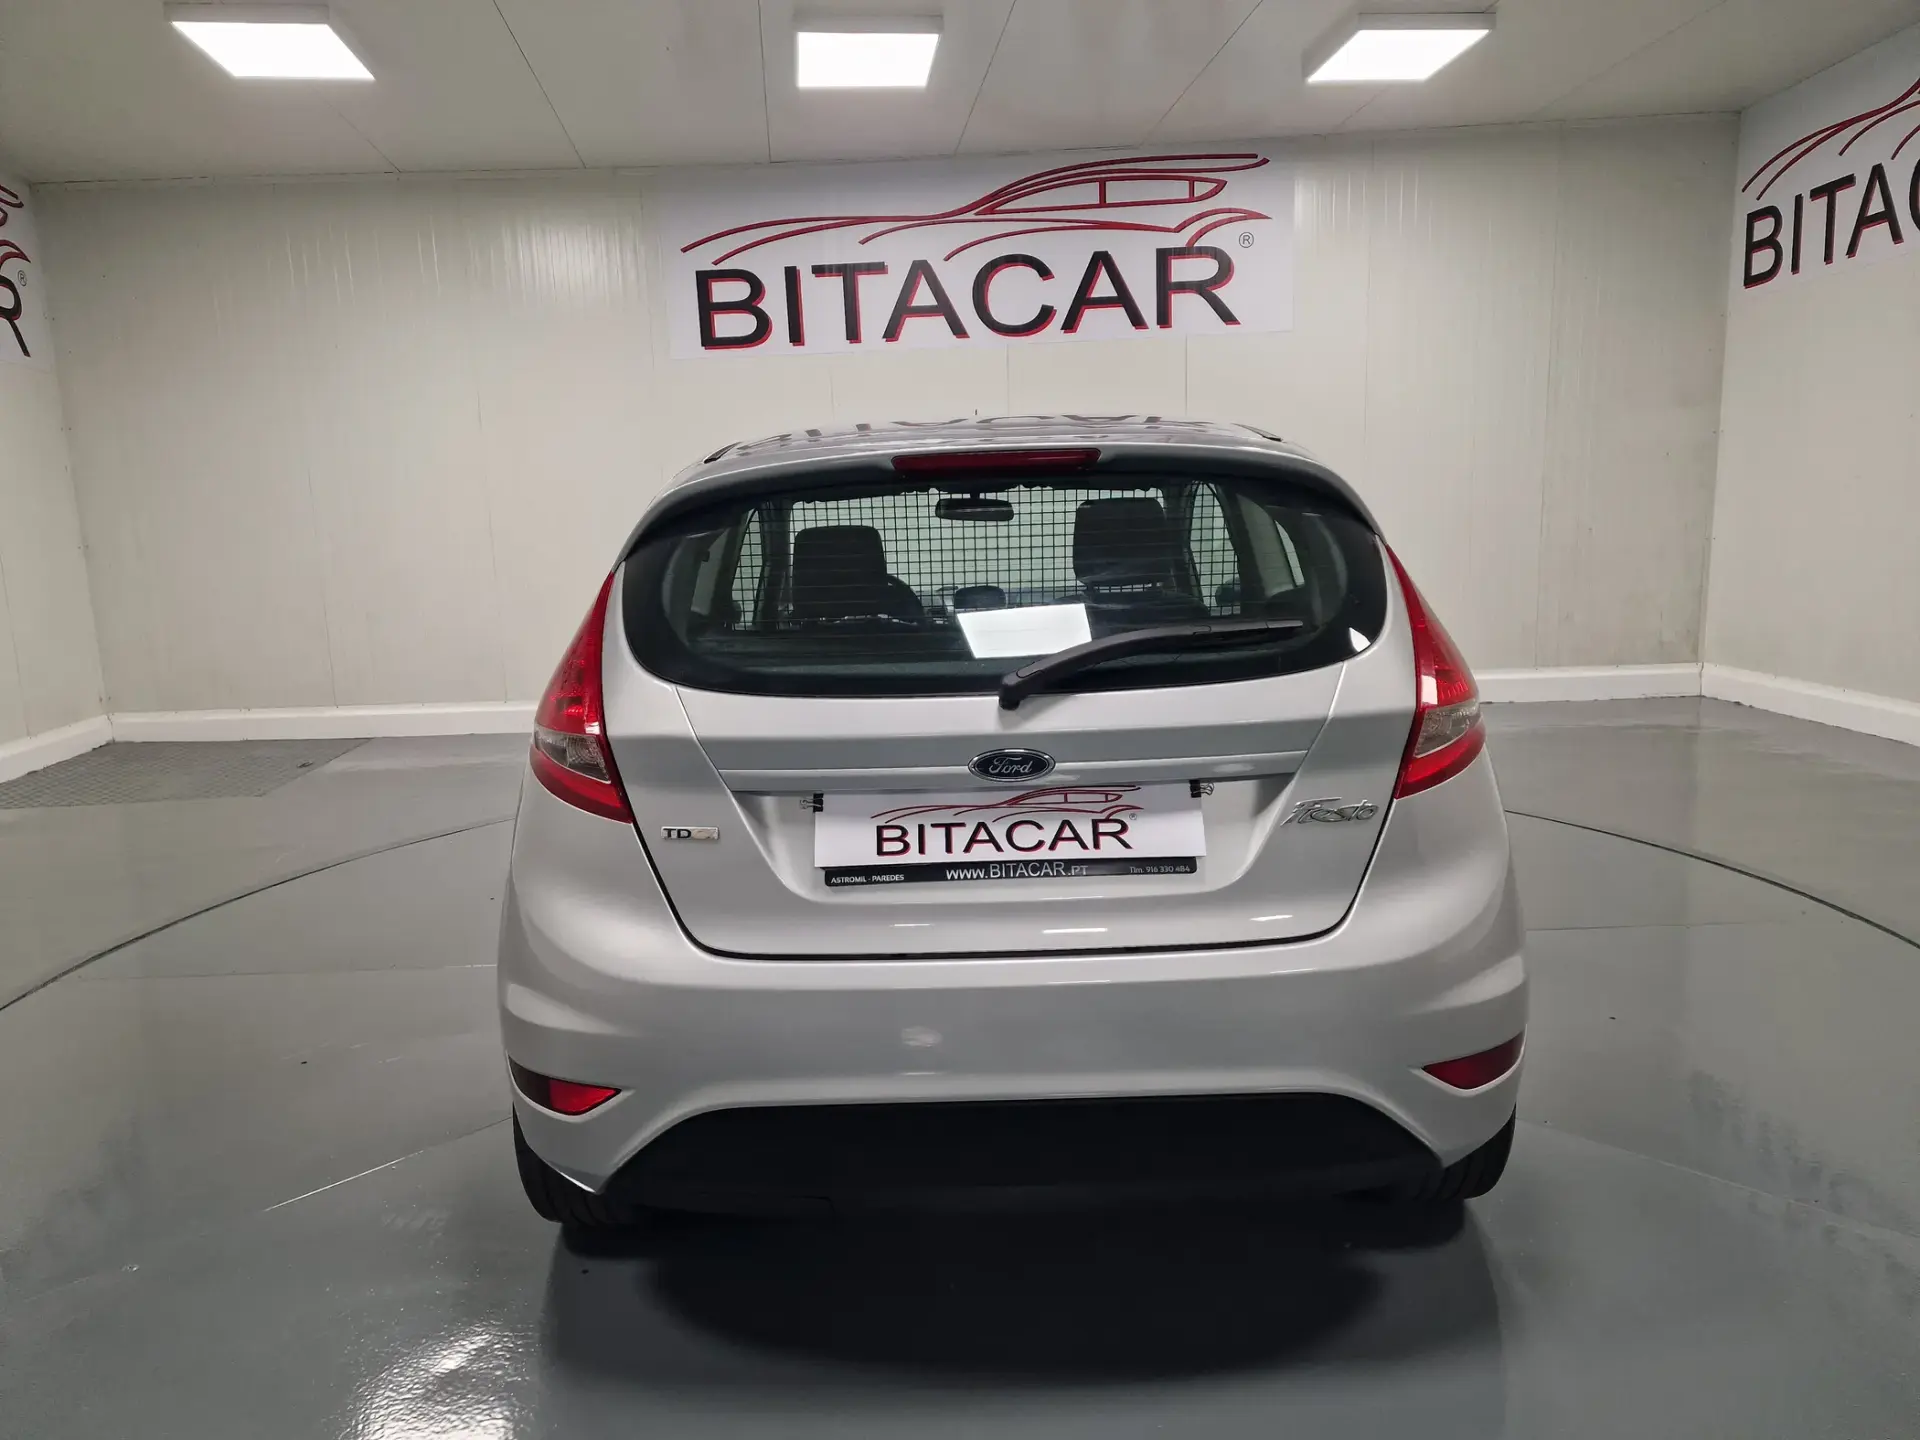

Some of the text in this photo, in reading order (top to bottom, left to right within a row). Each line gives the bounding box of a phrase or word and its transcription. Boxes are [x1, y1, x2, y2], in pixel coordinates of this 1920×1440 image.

[1743, 159, 1920, 289] BITA
[695, 245, 1241, 350] BITACAR
[989, 756, 1034, 774] Ford
[1280, 796, 1379, 826] Fiesta
[876, 818, 1134, 857] BITACAR
[830, 875, 867, 884] ASTROMIL
[872, 874, 905, 882] PAREDES
[1160, 865, 1174, 873] 330
